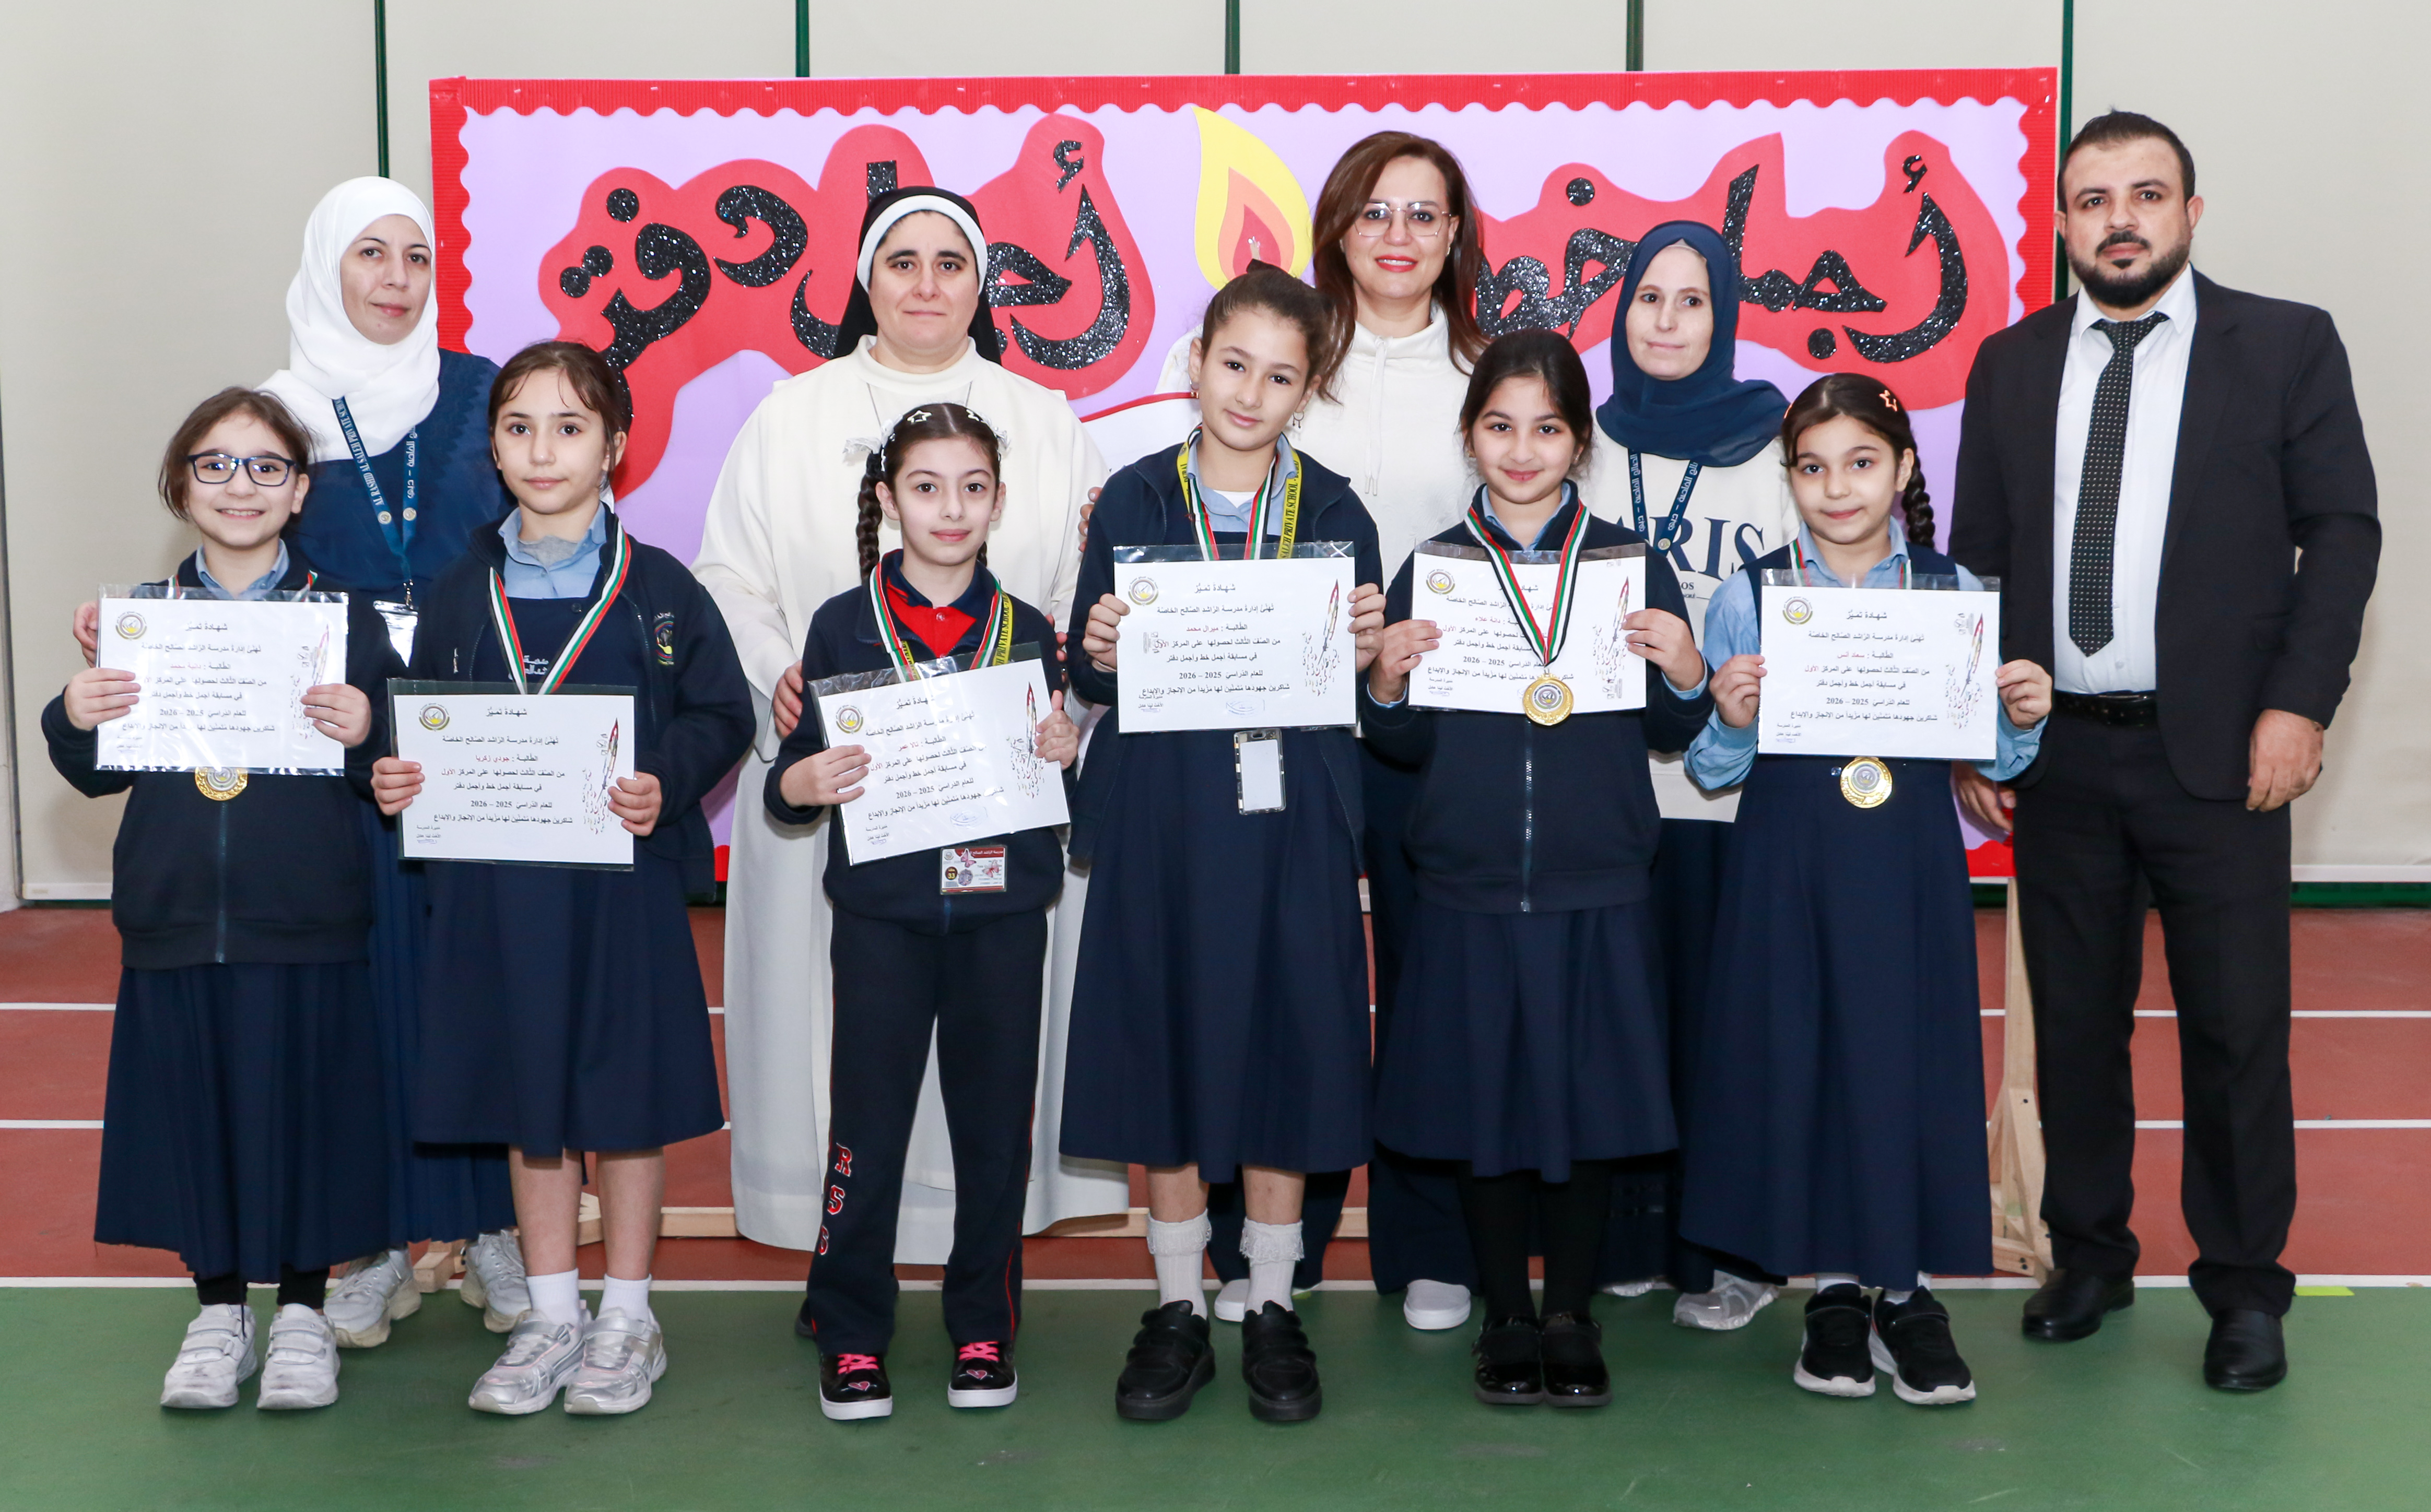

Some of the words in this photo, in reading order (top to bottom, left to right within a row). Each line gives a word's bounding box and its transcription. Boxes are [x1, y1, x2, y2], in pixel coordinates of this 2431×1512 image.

[351, 442, 367, 463] SALEH
[360, 463, 370, 471] AL
[363, 472, 380, 496] RASHID
[1287, 483, 1298, 508] SCHOOL
[373, 495, 384, 505] AL
[1284, 509, 1295, 536] PRIVATE
[1281, 536, 1291, 558] SALEH
[1615, 515, 1764, 581] RIS
